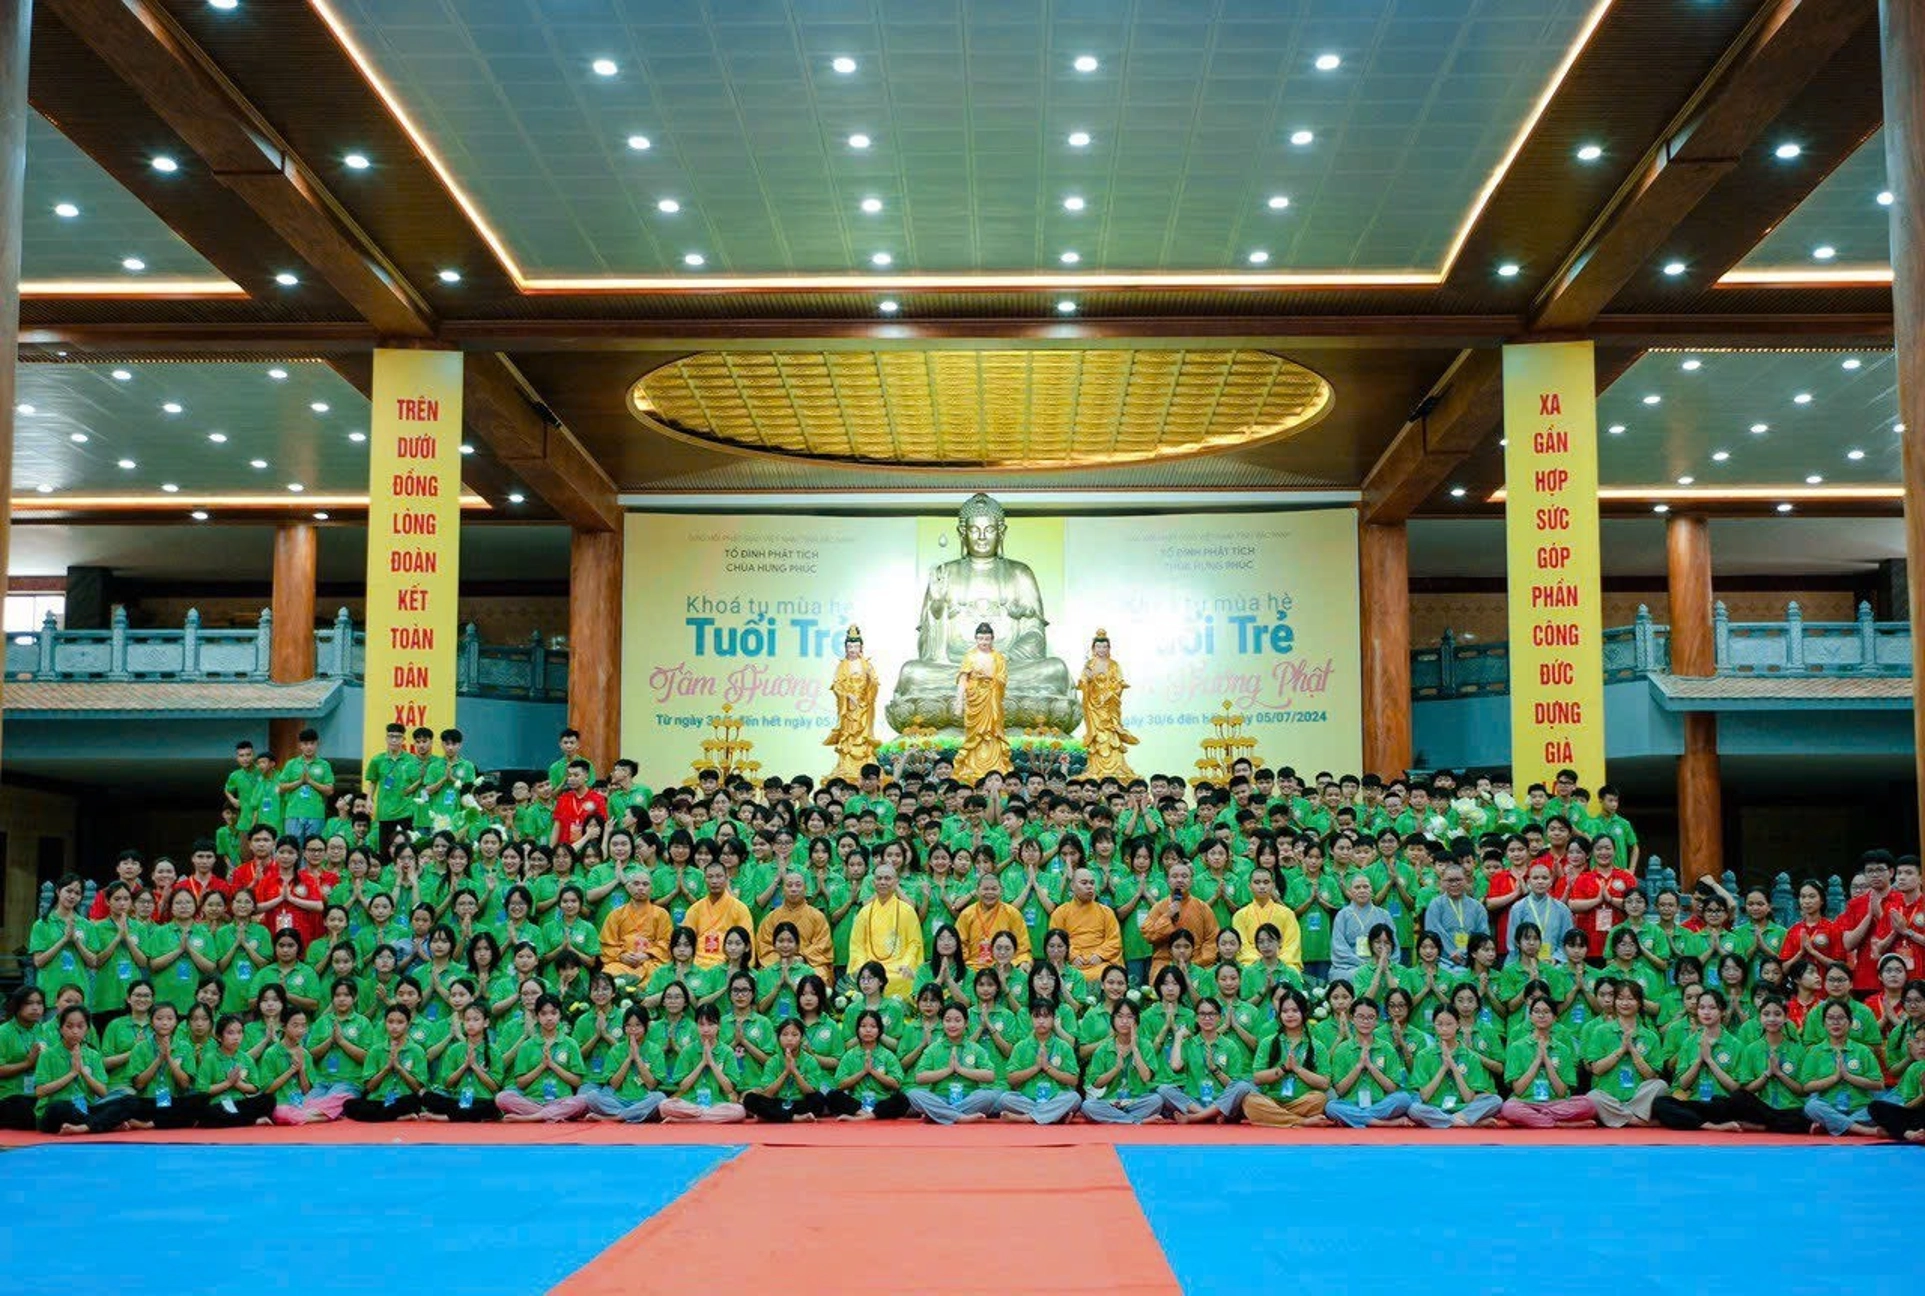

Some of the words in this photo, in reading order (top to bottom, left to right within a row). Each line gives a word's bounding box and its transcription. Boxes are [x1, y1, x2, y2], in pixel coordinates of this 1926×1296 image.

[397, 395, 439, 422] TRÊN
[1540, 393, 1561, 416] XA
[397, 433, 436, 459] DƯỚI
[1533, 424, 1569, 454] GẦN
[392, 468, 438, 497] ĐỒNG
[1535, 470, 1568, 497] HỢP
[393, 508, 436, 535] LÒNG
[1536, 504, 1570, 530] SỨC
[391, 547, 436, 573] ĐOÀN
[1537, 542, 1570, 569] GÓP
[398, 583, 429, 611] KẾT
[686, 595, 741, 614] Khoá
[777, 596, 822, 615] mùa
[1215, 594, 1260, 613] mùa
[1268, 592, 1293, 611] hè
[1532, 578, 1579, 608] PHẦN
[391, 624, 434, 650] TOÀN
[685, 612, 776, 657] Tuổi
[1228, 609, 1294, 655] Trẻ
[1533, 620, 1579, 647] CÔNG
[394, 661, 429, 688] DÂN
[649, 661, 716, 703] Tâm
[1272, 658, 1334, 698] Phật
[1540, 659, 1574, 685] ĐỨC
[394, 700, 427, 726] XÂY
[656, 713, 672, 725] Từ
[674, 714, 703, 728] ngày
[1256, 711, 1327, 723] 05/07/2024
[1535, 702, 1581, 729] DỰNG
[1545, 736, 1573, 763] GIÀ
